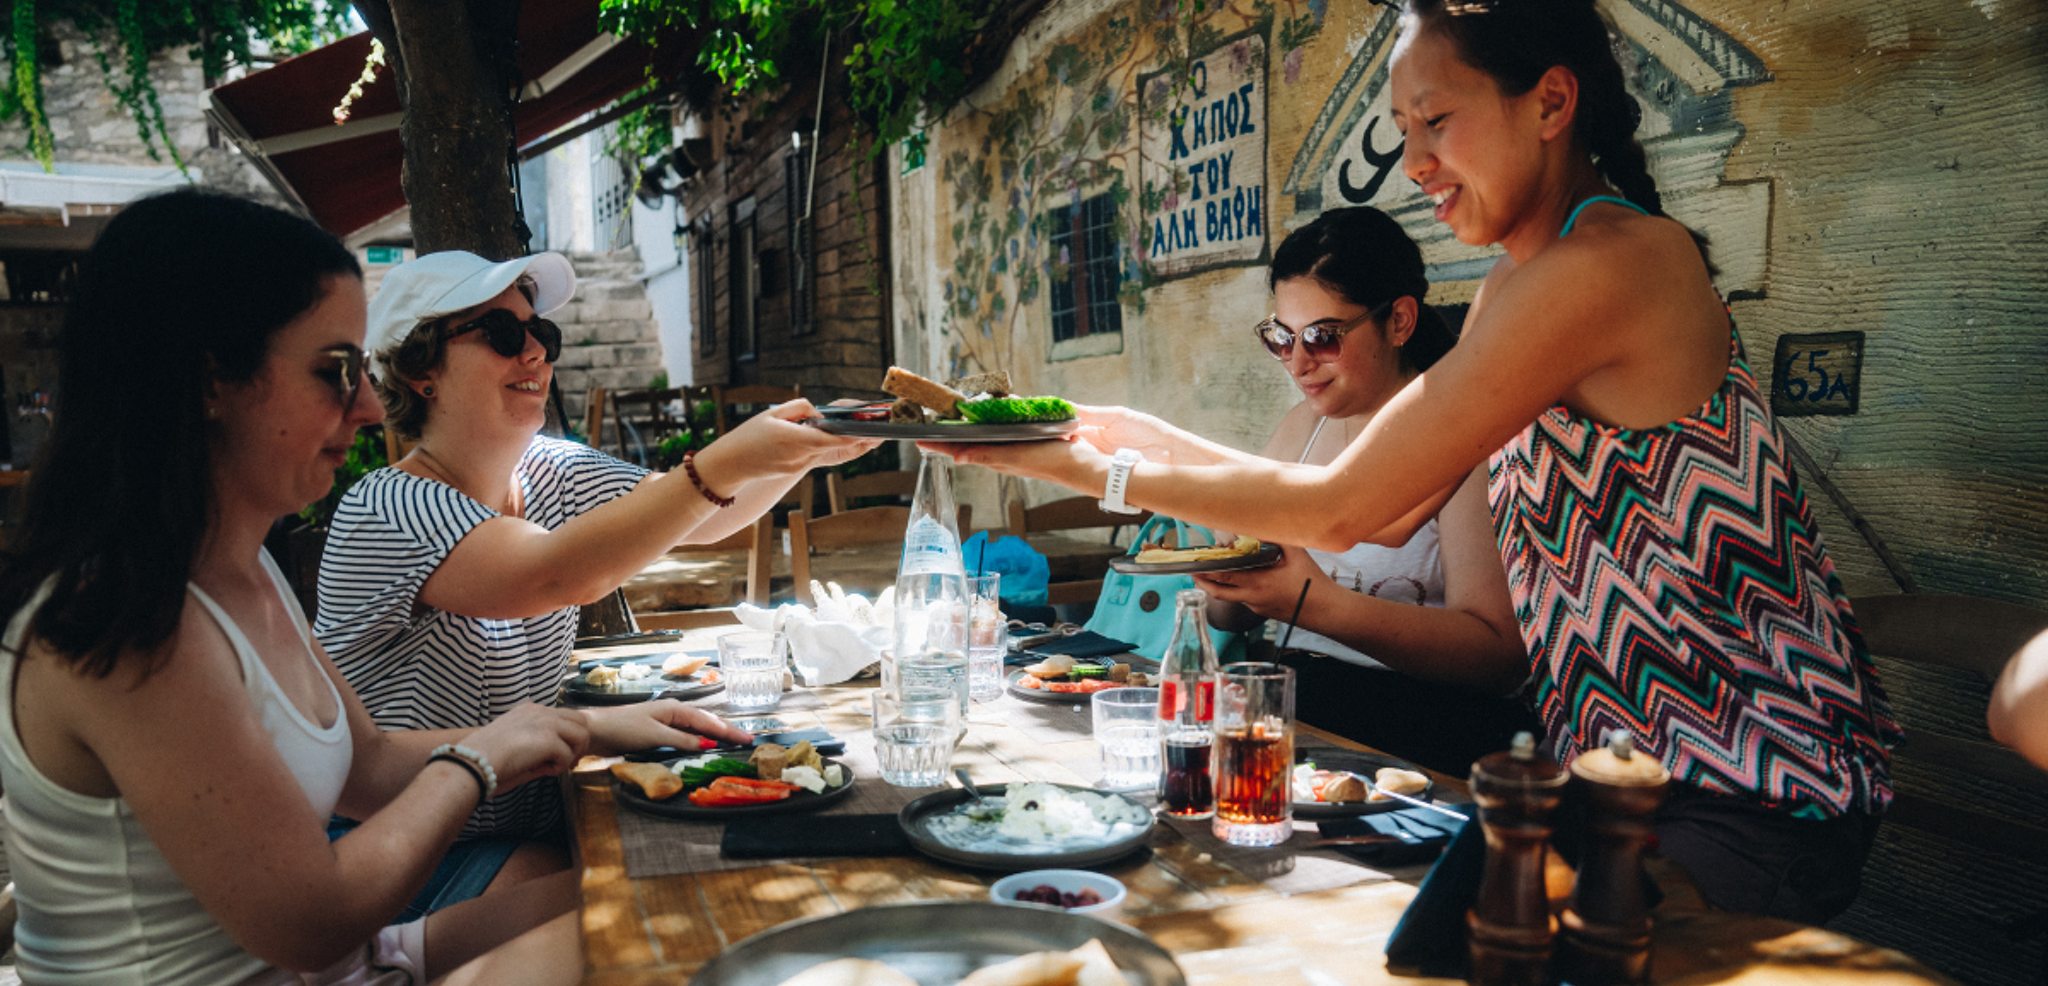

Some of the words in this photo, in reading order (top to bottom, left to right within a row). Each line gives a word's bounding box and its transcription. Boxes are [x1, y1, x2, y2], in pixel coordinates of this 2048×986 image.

[1169, 83, 1255, 160] ΚΗΠΟΣ
[1188, 150, 1234, 201] ΤΟΥ
[1206, 185, 1261, 242] ΒΑΦΗ
